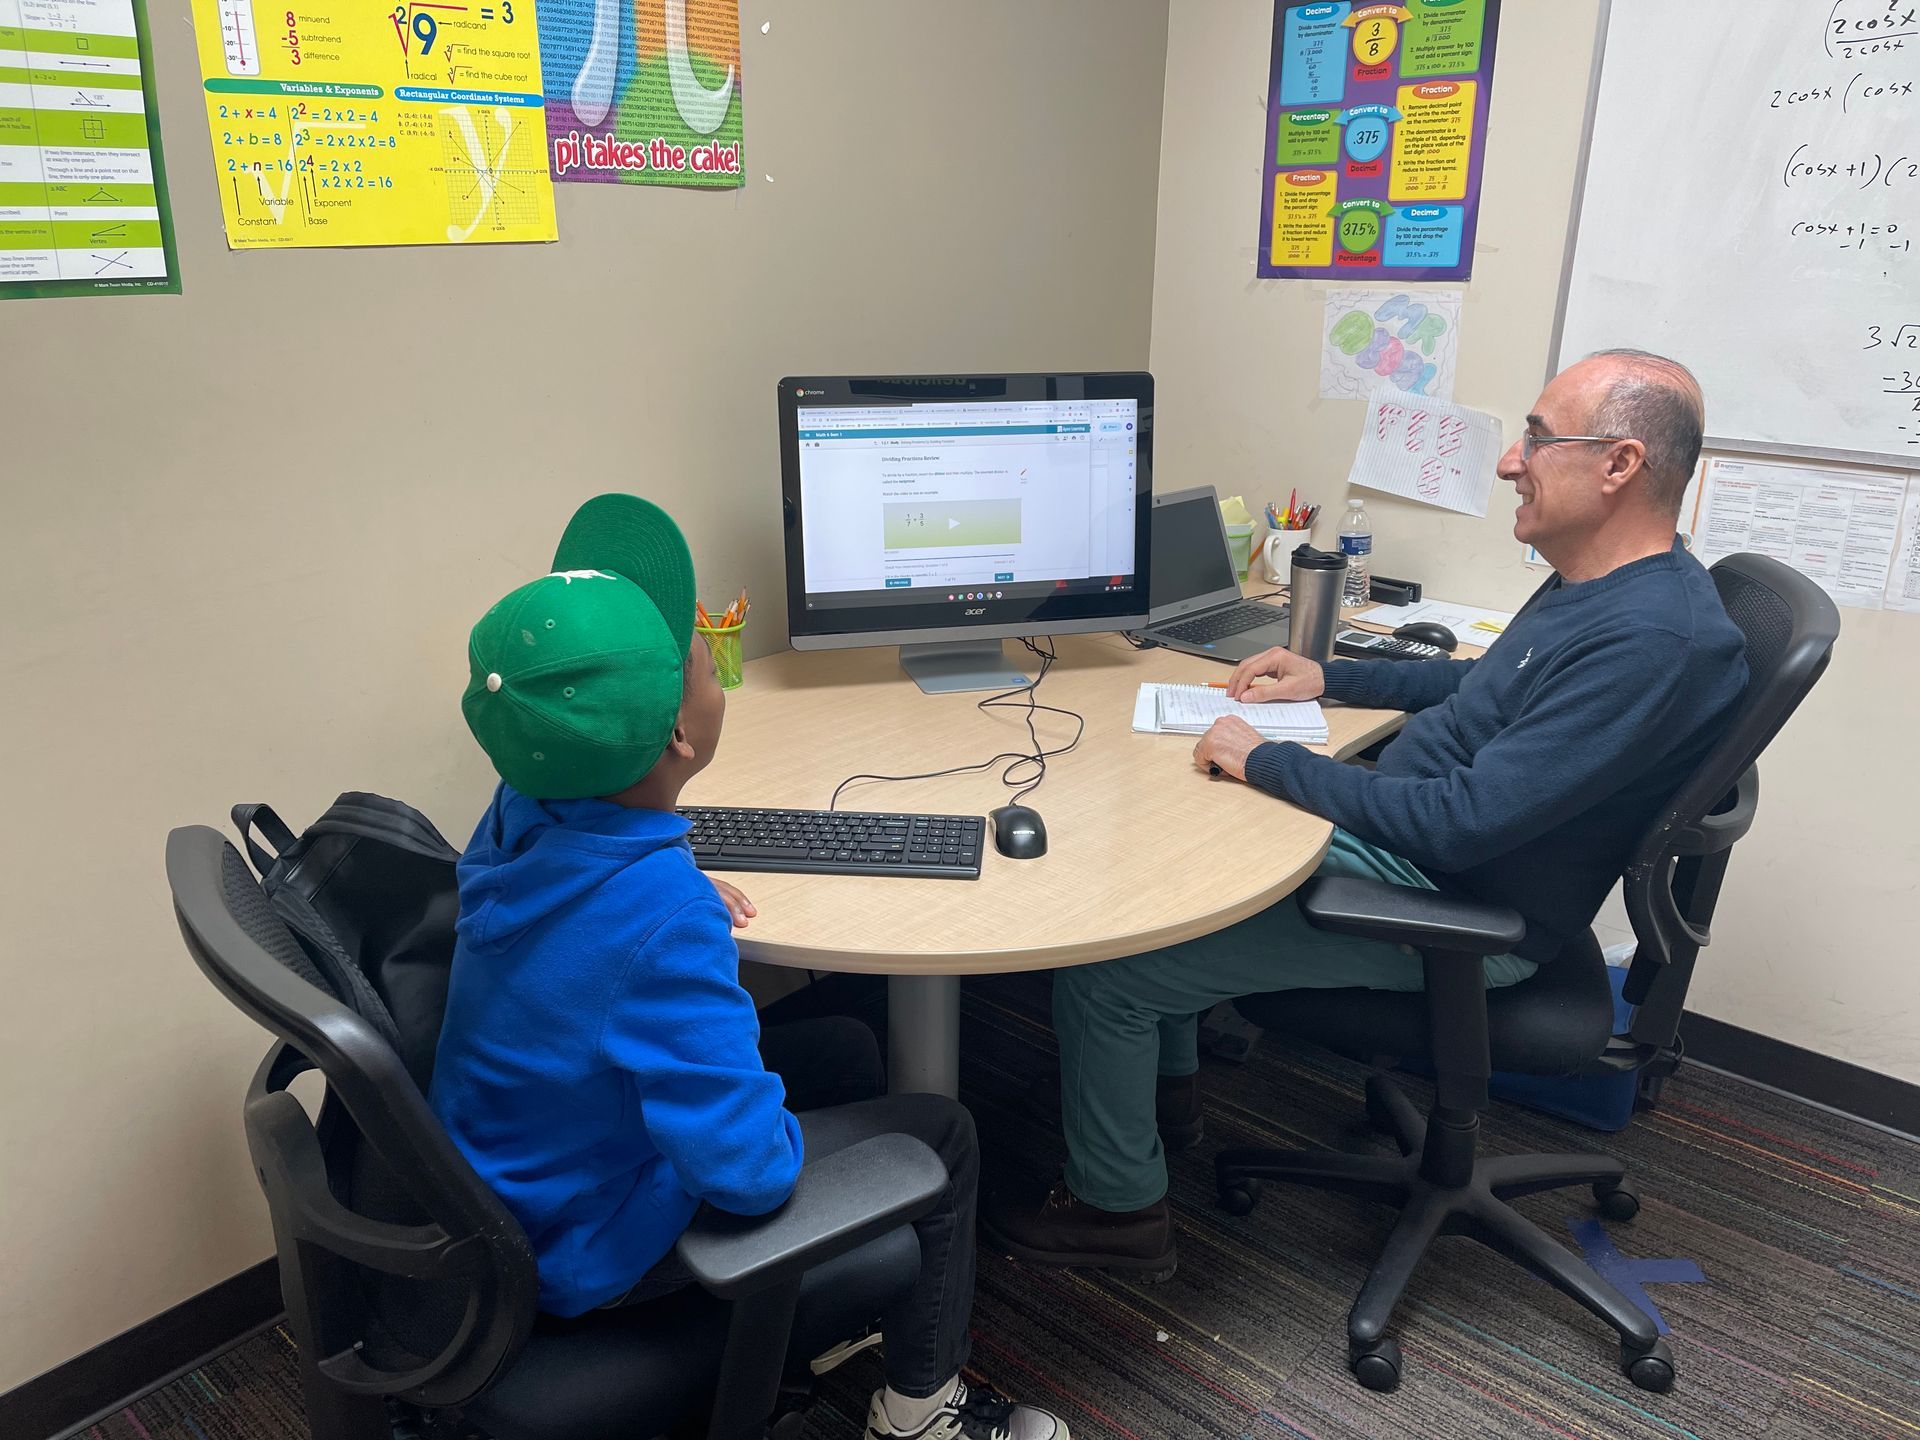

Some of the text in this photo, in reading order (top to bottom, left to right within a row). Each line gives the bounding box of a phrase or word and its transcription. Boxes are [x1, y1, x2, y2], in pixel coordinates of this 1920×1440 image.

[1306, 6, 1332, 16] Decimal
[1358, 7, 1386, 17] Convert
[286, 11, 330, 28] 8 minuend
[453, 20, 487, 30] radicand
[396, 6, 407, 24] 2
[412, 12, 437, 56] 9
[502, 1, 514, 24] 3
[1372, 22, 1380, 36] 3
[282, 30, 342, 46] -5 subtrahend
[463, 47, 477, 56] find
[479, 48, 488, 56] the
[491, 50, 515, 60] square
[1369, 43, 1379, 56] 8
[291, 49, 340, 66] 3 difference
[411, 72, 438, 80] radical
[466, 70, 480, 79] find
[494, 72, 512, 81] cube
[1358, 67, 1388, 76] Fraction
[280, 83, 323, 94] Variables
[335, 86, 379, 96] Exponents
[400, 88, 525, 104] Rectangular Coordinate Systems
[1420, 85, 1452, 94] Fraction
[220, 105, 228, 118] 2
[245, 108, 253, 118] x
[268, 106, 277, 118] 4
[324, 109, 332, 120] 2
[348, 110, 355, 121] 2
[370, 111, 378, 122] 4
[1292, 113, 1330, 122] Percentage
[1350, 106, 1378, 116] Convert
[224, 132, 232, 145] 2
[250, 133, 258, 144] b
[274, 133, 282, 145] 8
[328, 134, 335, 146] 2
[348, 136, 356, 147] 2
[368, 136, 376, 148] 2
[388, 136, 396, 148] 8
[1353, 130, 1380, 144] .375
[556, 132, 740, 173] pi takes the cake!
[228, 159, 236, 172] 2
[254, 160, 262, 171] n
[278, 160, 293, 172] 16
[332, 160, 339, 172] 2
[354, 161, 362, 172] 2
[333, 176, 341, 187] 2
[356, 176, 364, 188] 2
[379, 176, 392, 188] 16
[259, 198, 294, 206] Variable
[314, 199, 352, 208] Exponent
[1342, 200, 1370, 208] Convert
[238, 218, 277, 226] Constant
[1343, 222, 1376, 236] 37.5%
[1792, 222, 1838, 236] cosx
[1338, 254, 1376, 263] Percentage
[964, 608, 986, 616] acer
